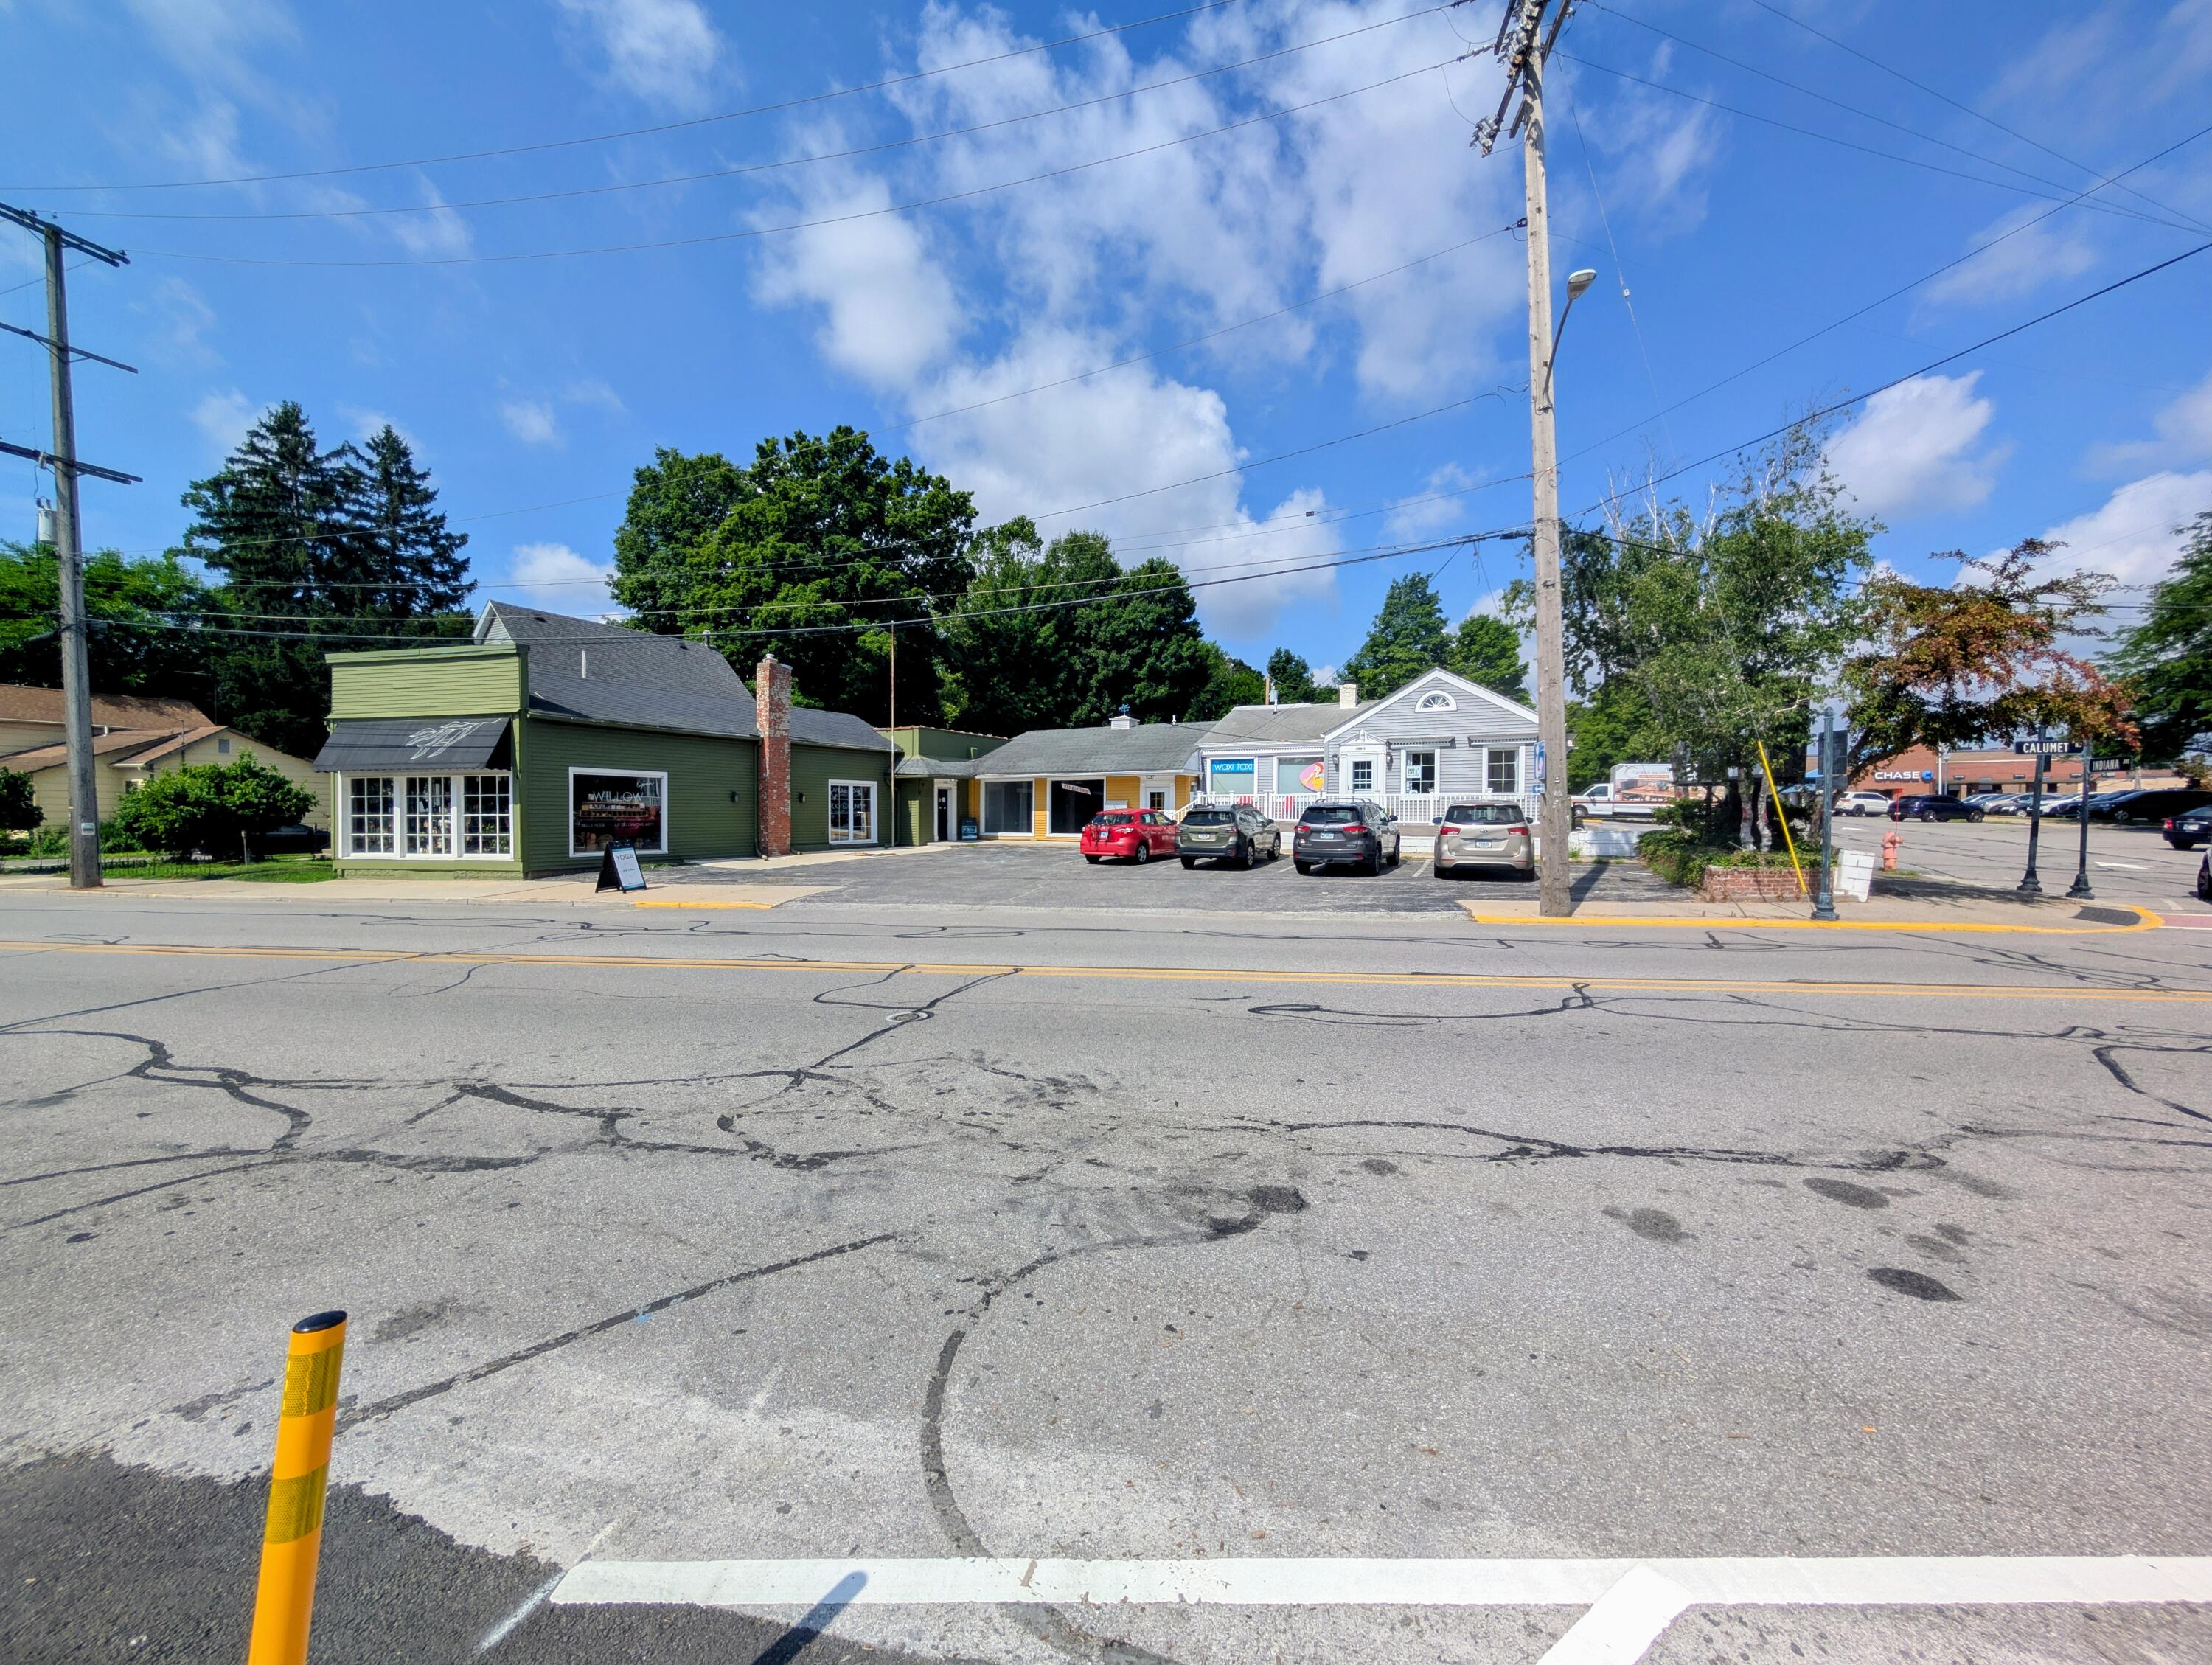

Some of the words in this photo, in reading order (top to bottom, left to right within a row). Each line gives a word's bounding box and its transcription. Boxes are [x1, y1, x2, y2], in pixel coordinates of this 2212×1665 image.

[2023, 743, 2069, 754] CALUMET
[2093, 759, 2120, 771] INDIANA
[1874, 771, 1921, 779] CHASE
[593, 790, 644, 802] WILLOW
